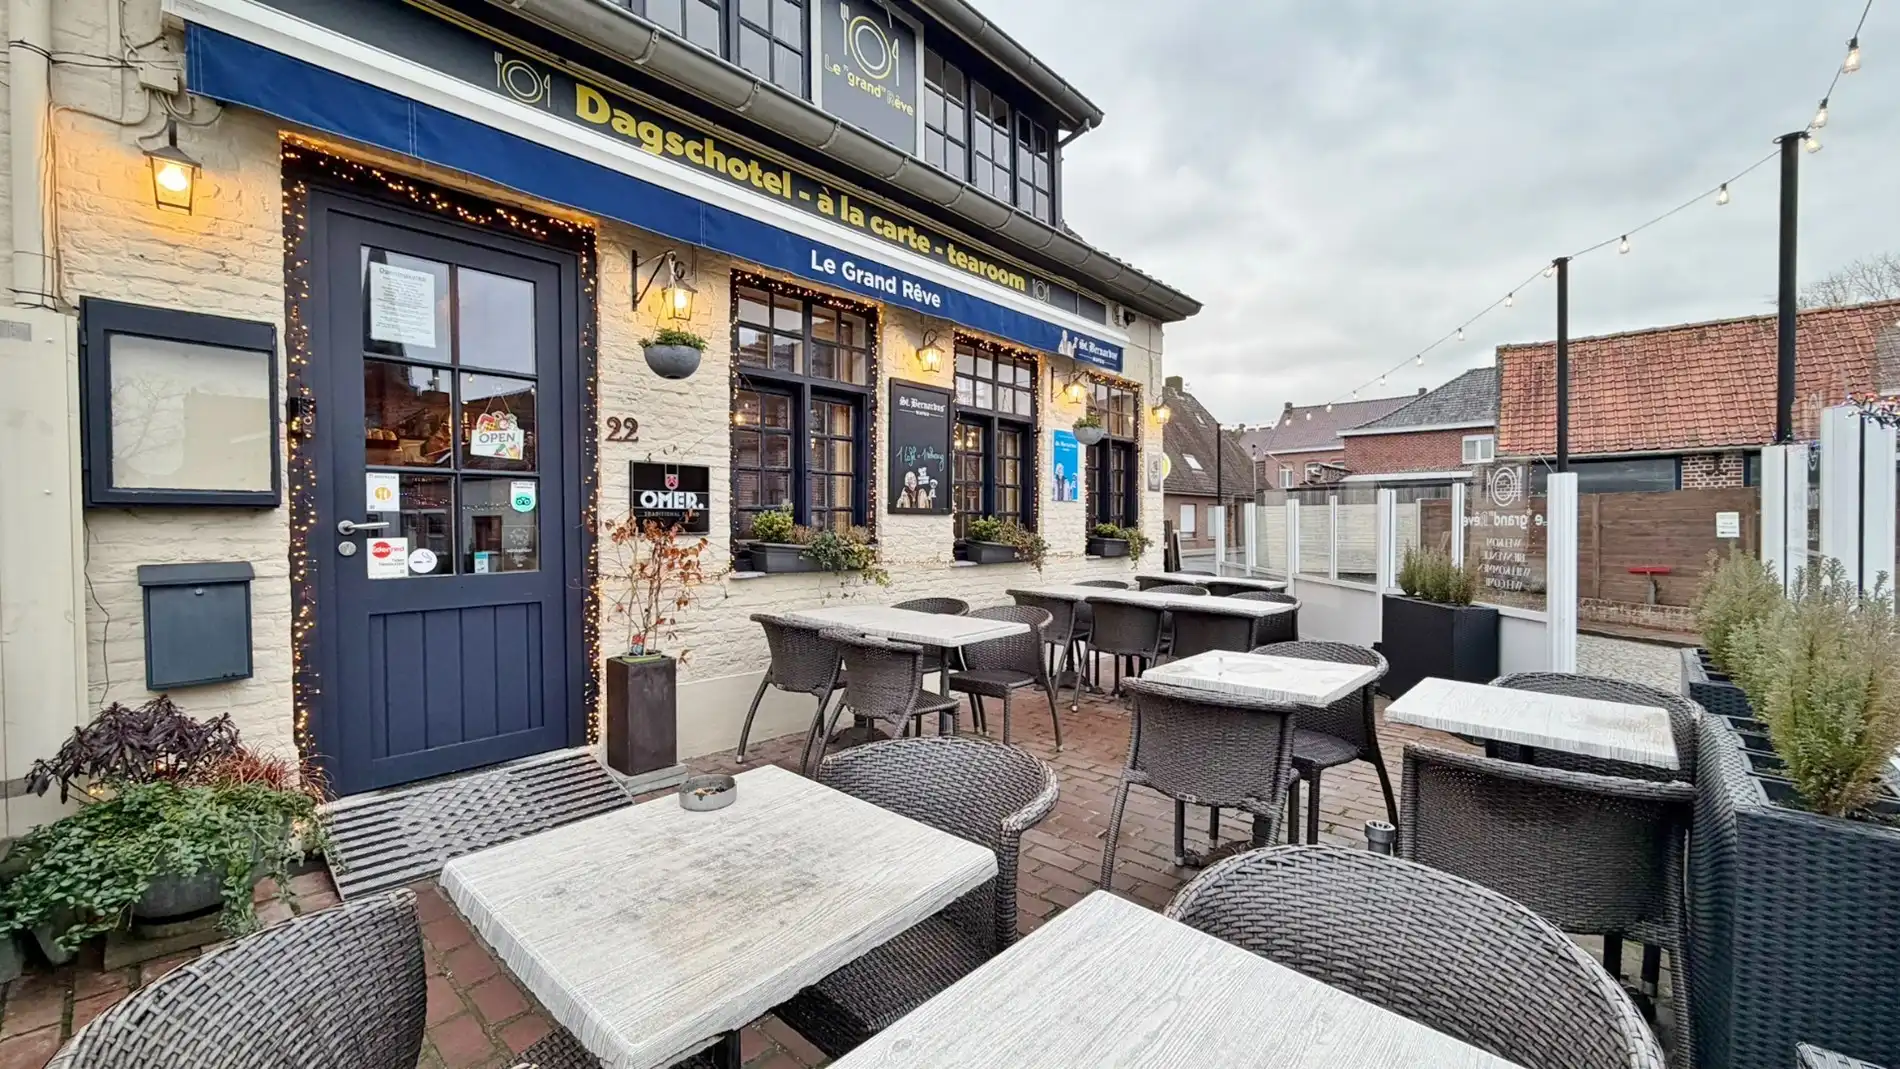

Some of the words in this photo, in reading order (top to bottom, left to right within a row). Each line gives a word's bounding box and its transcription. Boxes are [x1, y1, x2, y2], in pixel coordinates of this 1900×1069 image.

[825, 53, 841, 76] Le
[575, 83, 792, 199] Dagschotel
[817, 186, 834, 215] à
[841, 195, 864, 227] la
[870, 215, 930, 253] carte
[947, 243, 1025, 292] tearoom
[811, 249, 836, 275] Le
[842, 261, 897, 295] Grand
[902, 280, 941, 308] Rêve
[479, 432, 515, 444] OPEN
[605, 416, 639, 442] 22
[640, 491, 704, 509] OMER.
